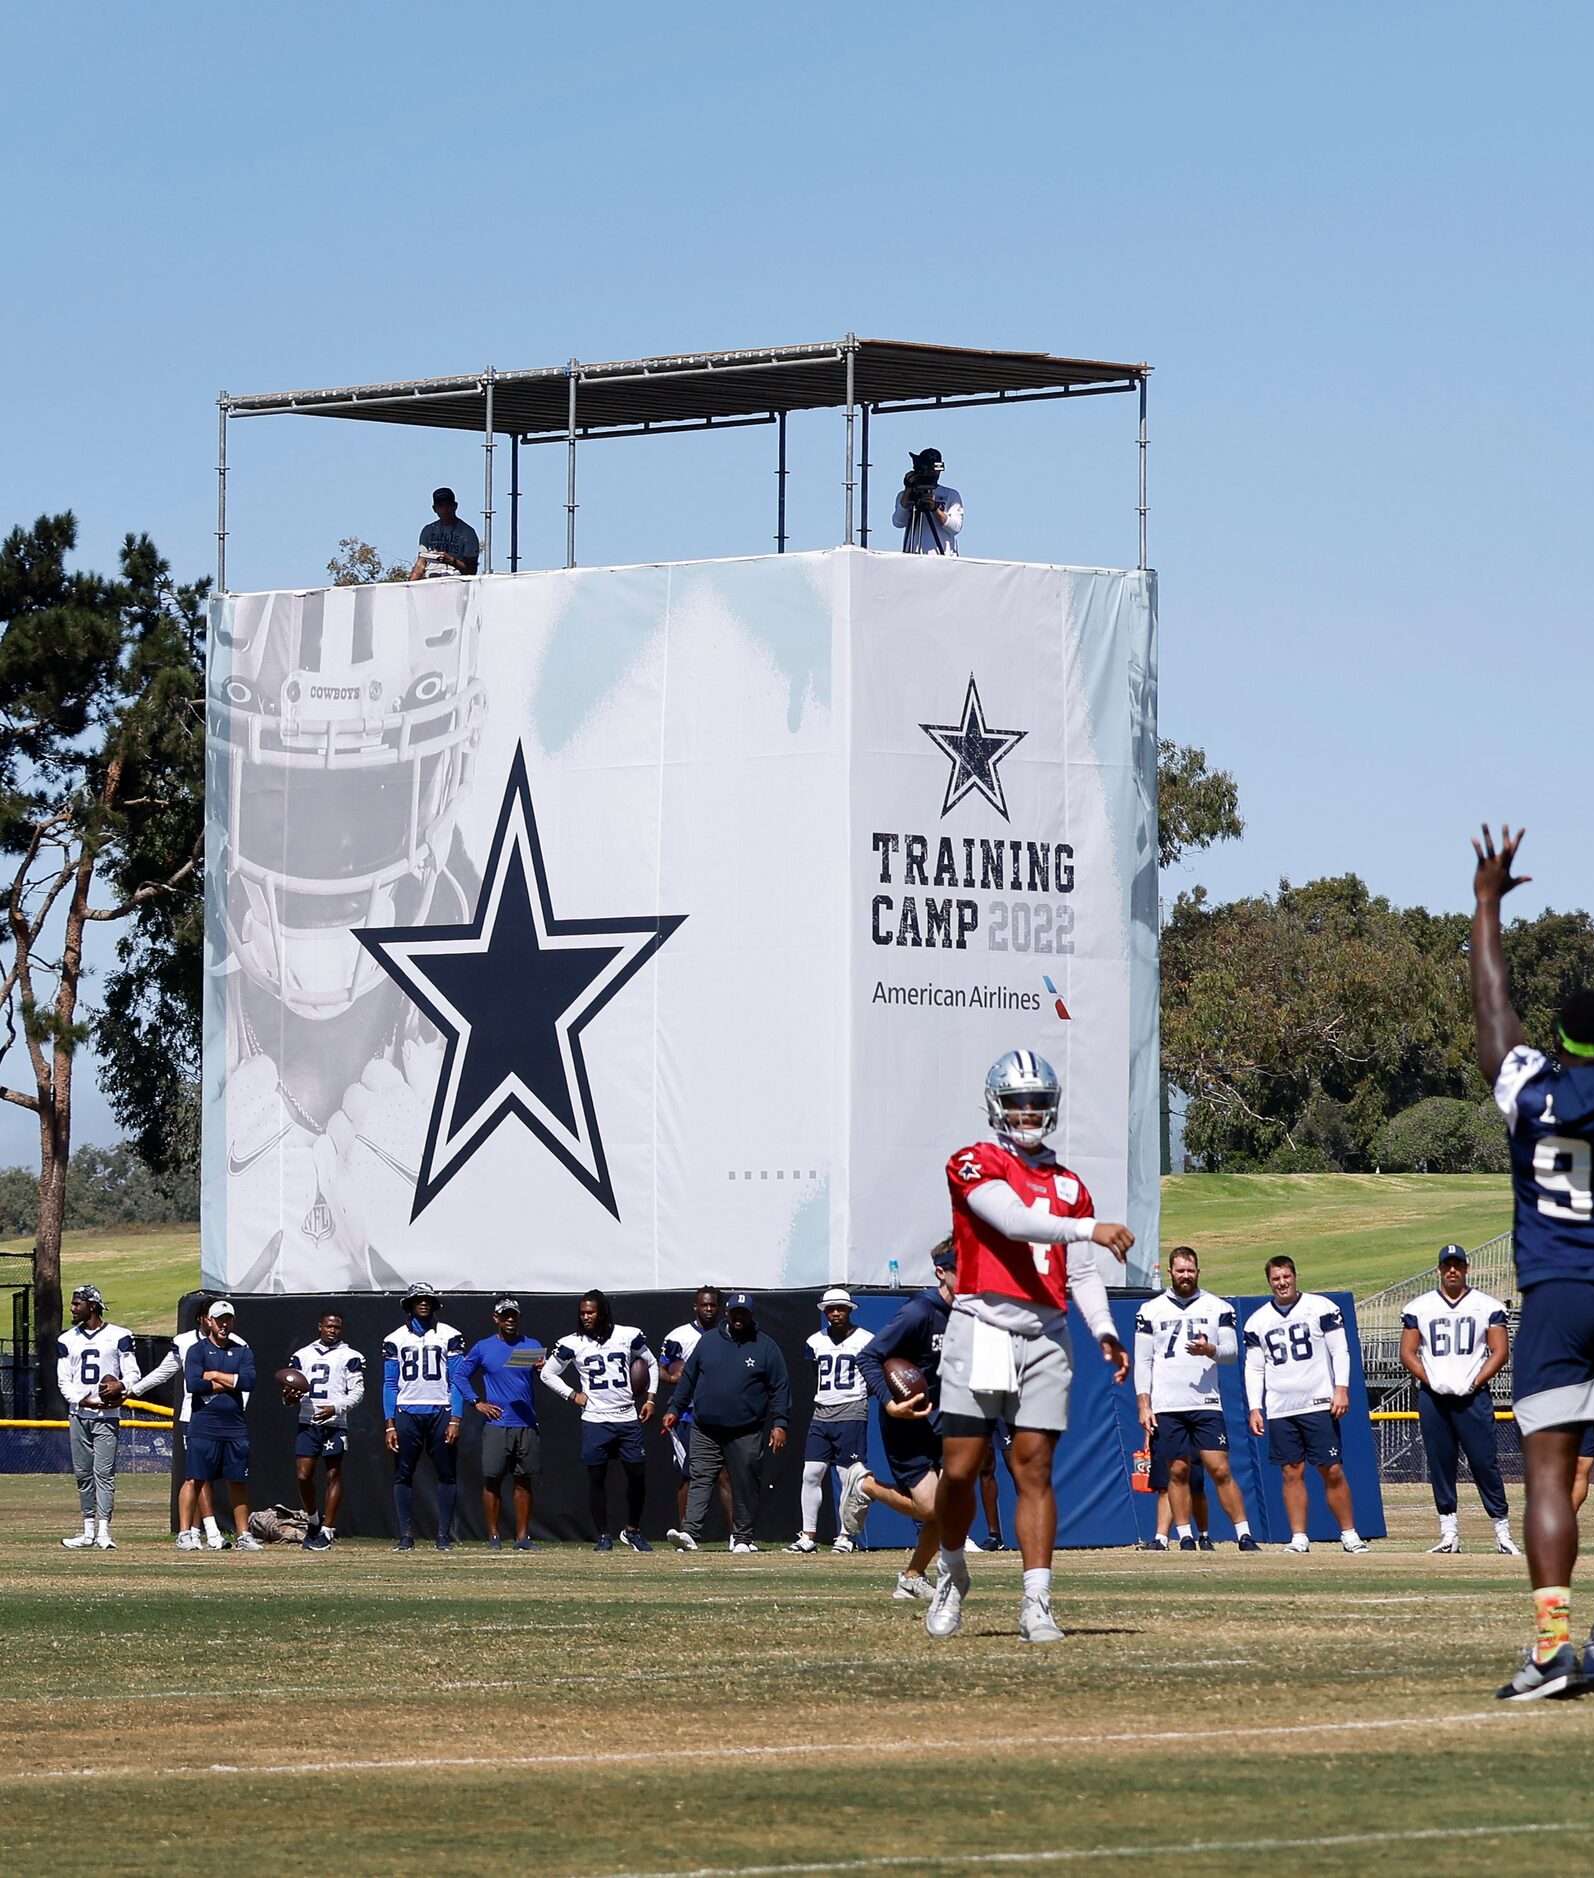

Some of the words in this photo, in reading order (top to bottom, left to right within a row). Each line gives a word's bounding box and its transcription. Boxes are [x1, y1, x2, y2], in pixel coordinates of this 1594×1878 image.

[310, 686, 360, 700] COWBOYS
[872, 832, 1075, 894] TRAINING
[872, 894, 979, 950] CAMP
[988, 901, 1075, 954] 2022
[872, 981, 967, 1008] American
[968, 985, 1041, 1011] Airlines
[1264, 1322, 1313, 1366] 68
[1429, 1316, 1476, 1357] 60
[81, 1349, 100, 1385] 6
[309, 1363, 330, 1399] 2
[401, 1345, 442, 1381] 80
[584, 1352, 628, 1390] 23
[817, 1354, 856, 1390] 20
